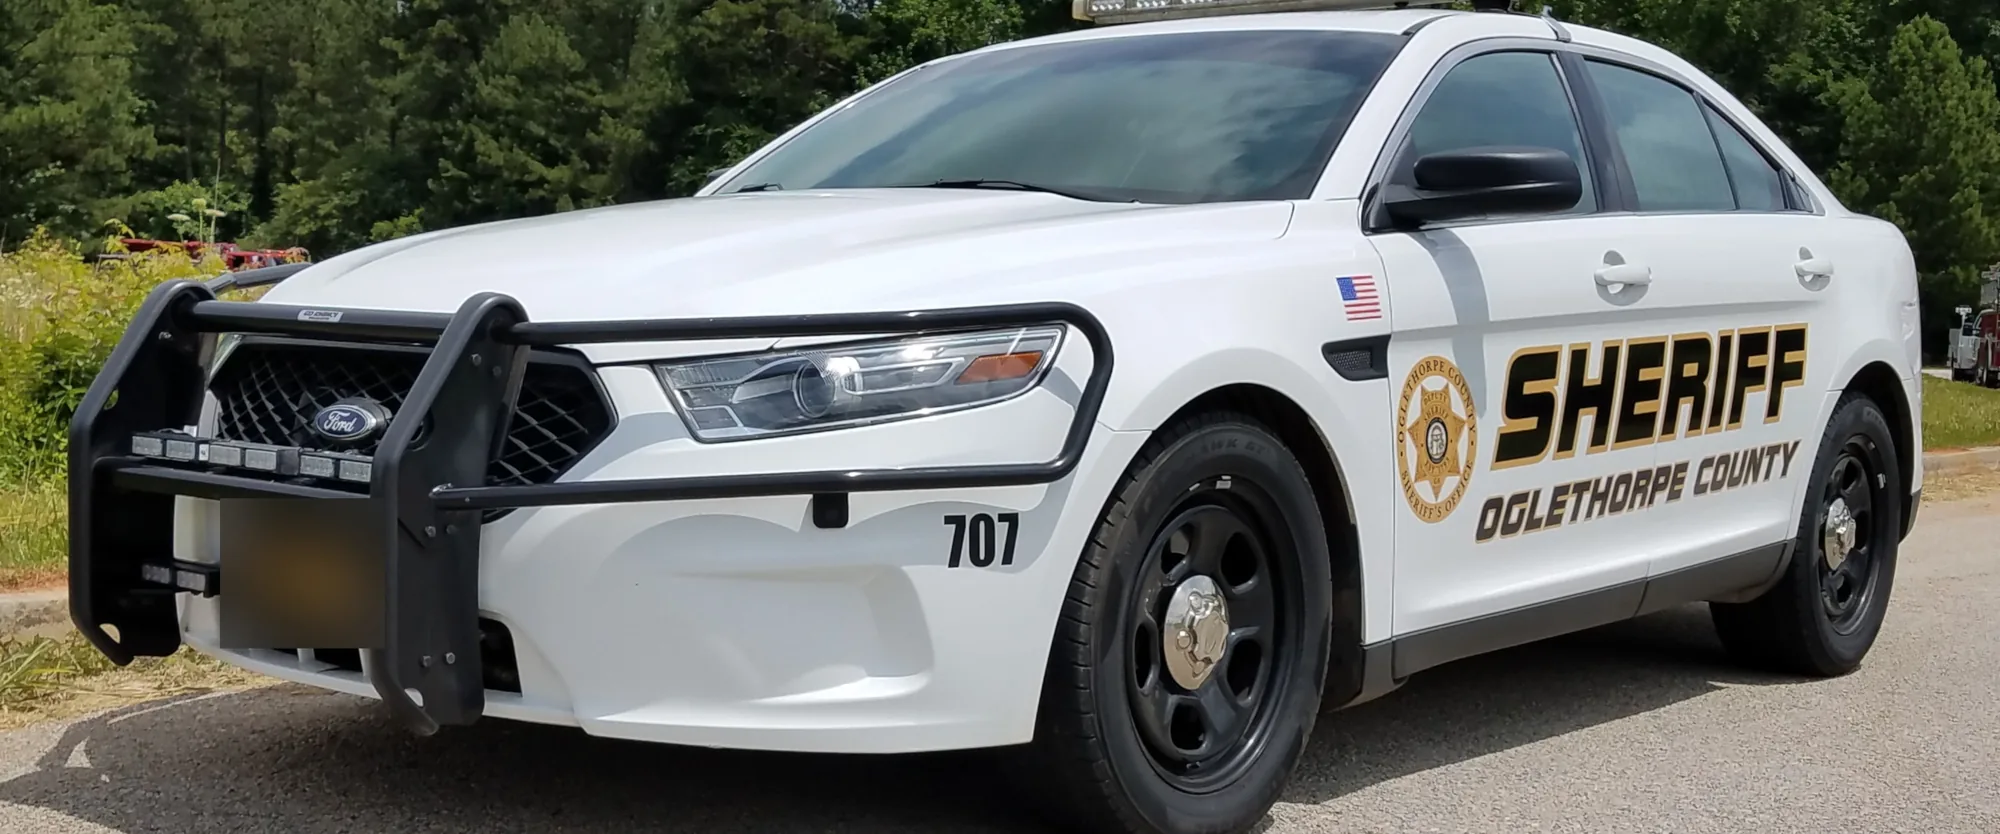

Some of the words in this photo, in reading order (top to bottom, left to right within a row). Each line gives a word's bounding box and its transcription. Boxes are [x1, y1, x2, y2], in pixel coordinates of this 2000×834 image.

[323, 410, 357, 432] Ford
[1398, 359, 1445, 443] OGLETHORPE
[1448, 367, 1476, 433] COUNTY
[1491, 323, 1808, 471] SHERIFF
[1402, 470, 1442, 519] SHERIFF'S
[1445, 460, 1473, 512] OFFICE
[1475, 461, 1690, 543] OGLETHORPE
[1693, 439, 1802, 497] COUNTY
[943, 512, 1019, 568] 707
